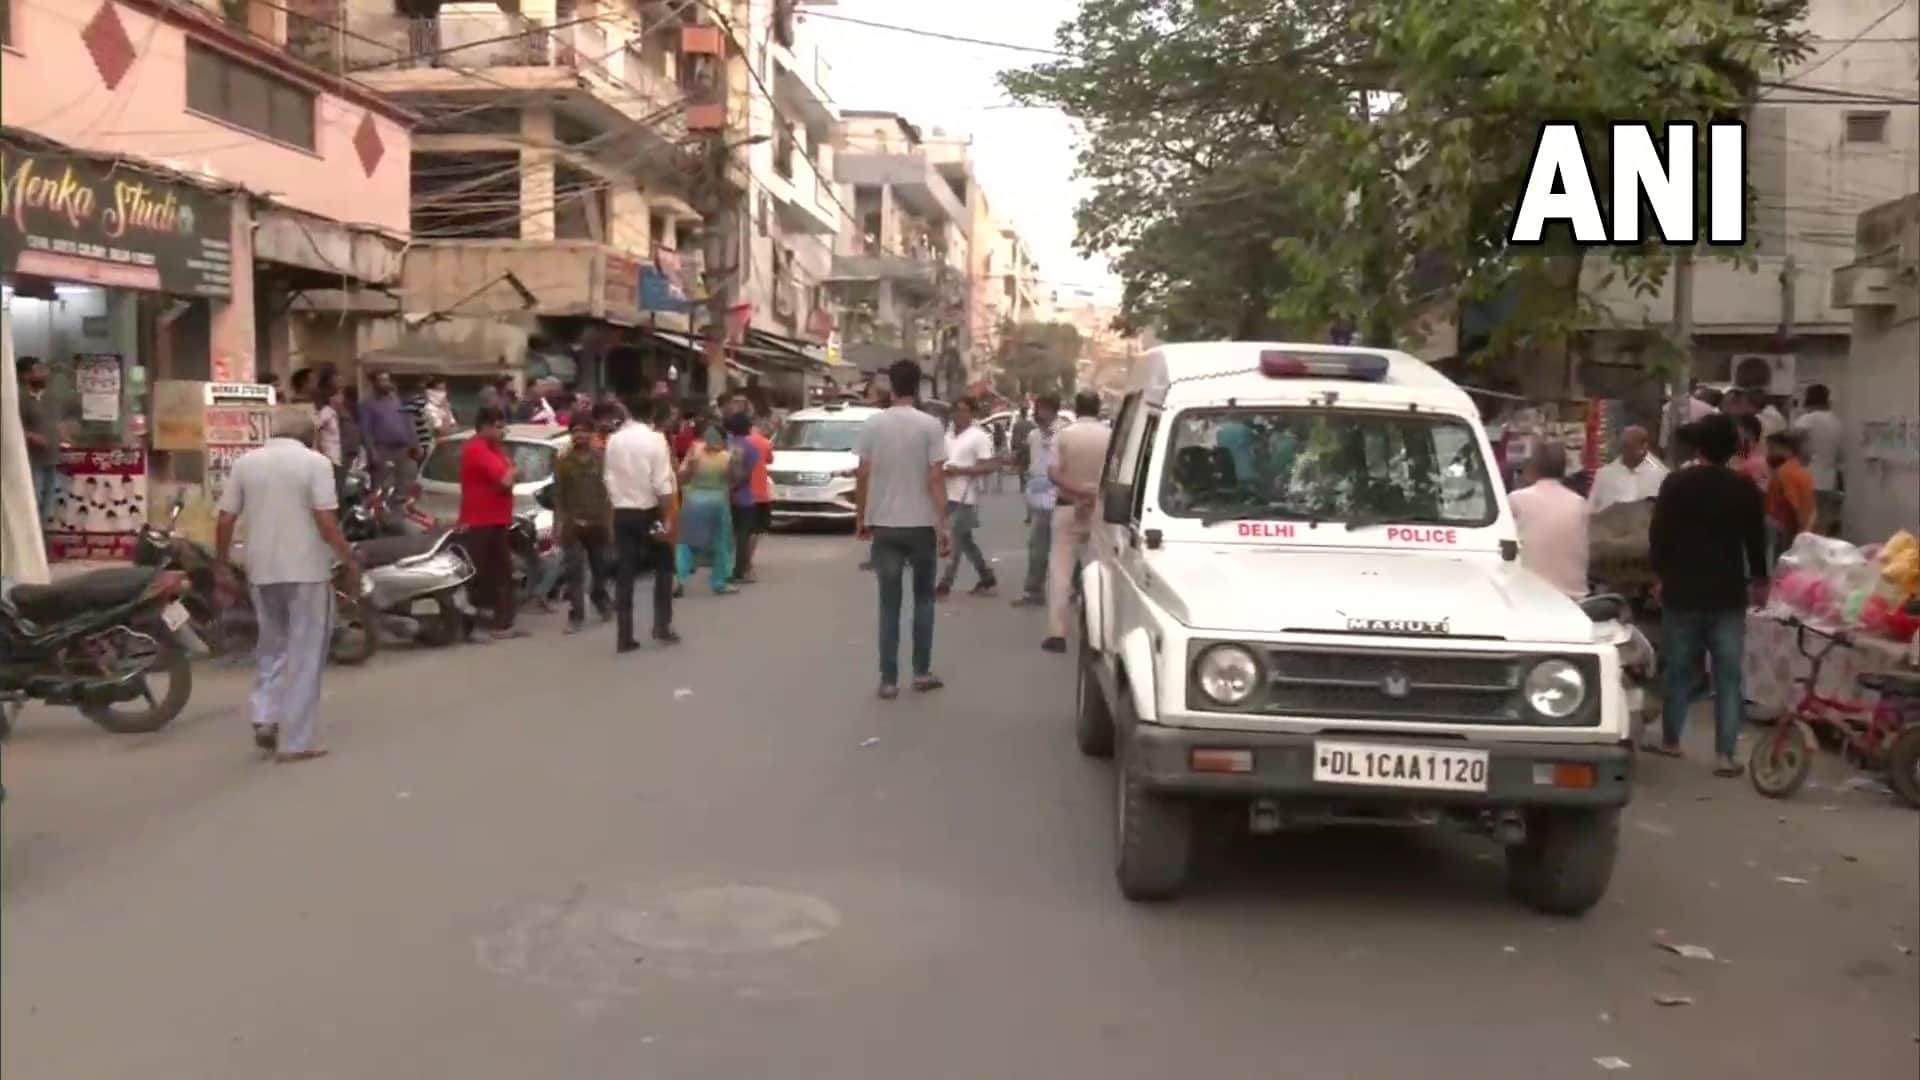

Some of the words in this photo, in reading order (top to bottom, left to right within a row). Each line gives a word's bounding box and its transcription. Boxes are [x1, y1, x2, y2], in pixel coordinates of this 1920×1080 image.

[1238, 523, 1295, 538] DELHI
[1387, 527, 1457, 544] POLICE
[1347, 618, 1450, 633] MARUTI
[1330, 750, 1485, 783] DL1CAA1120
